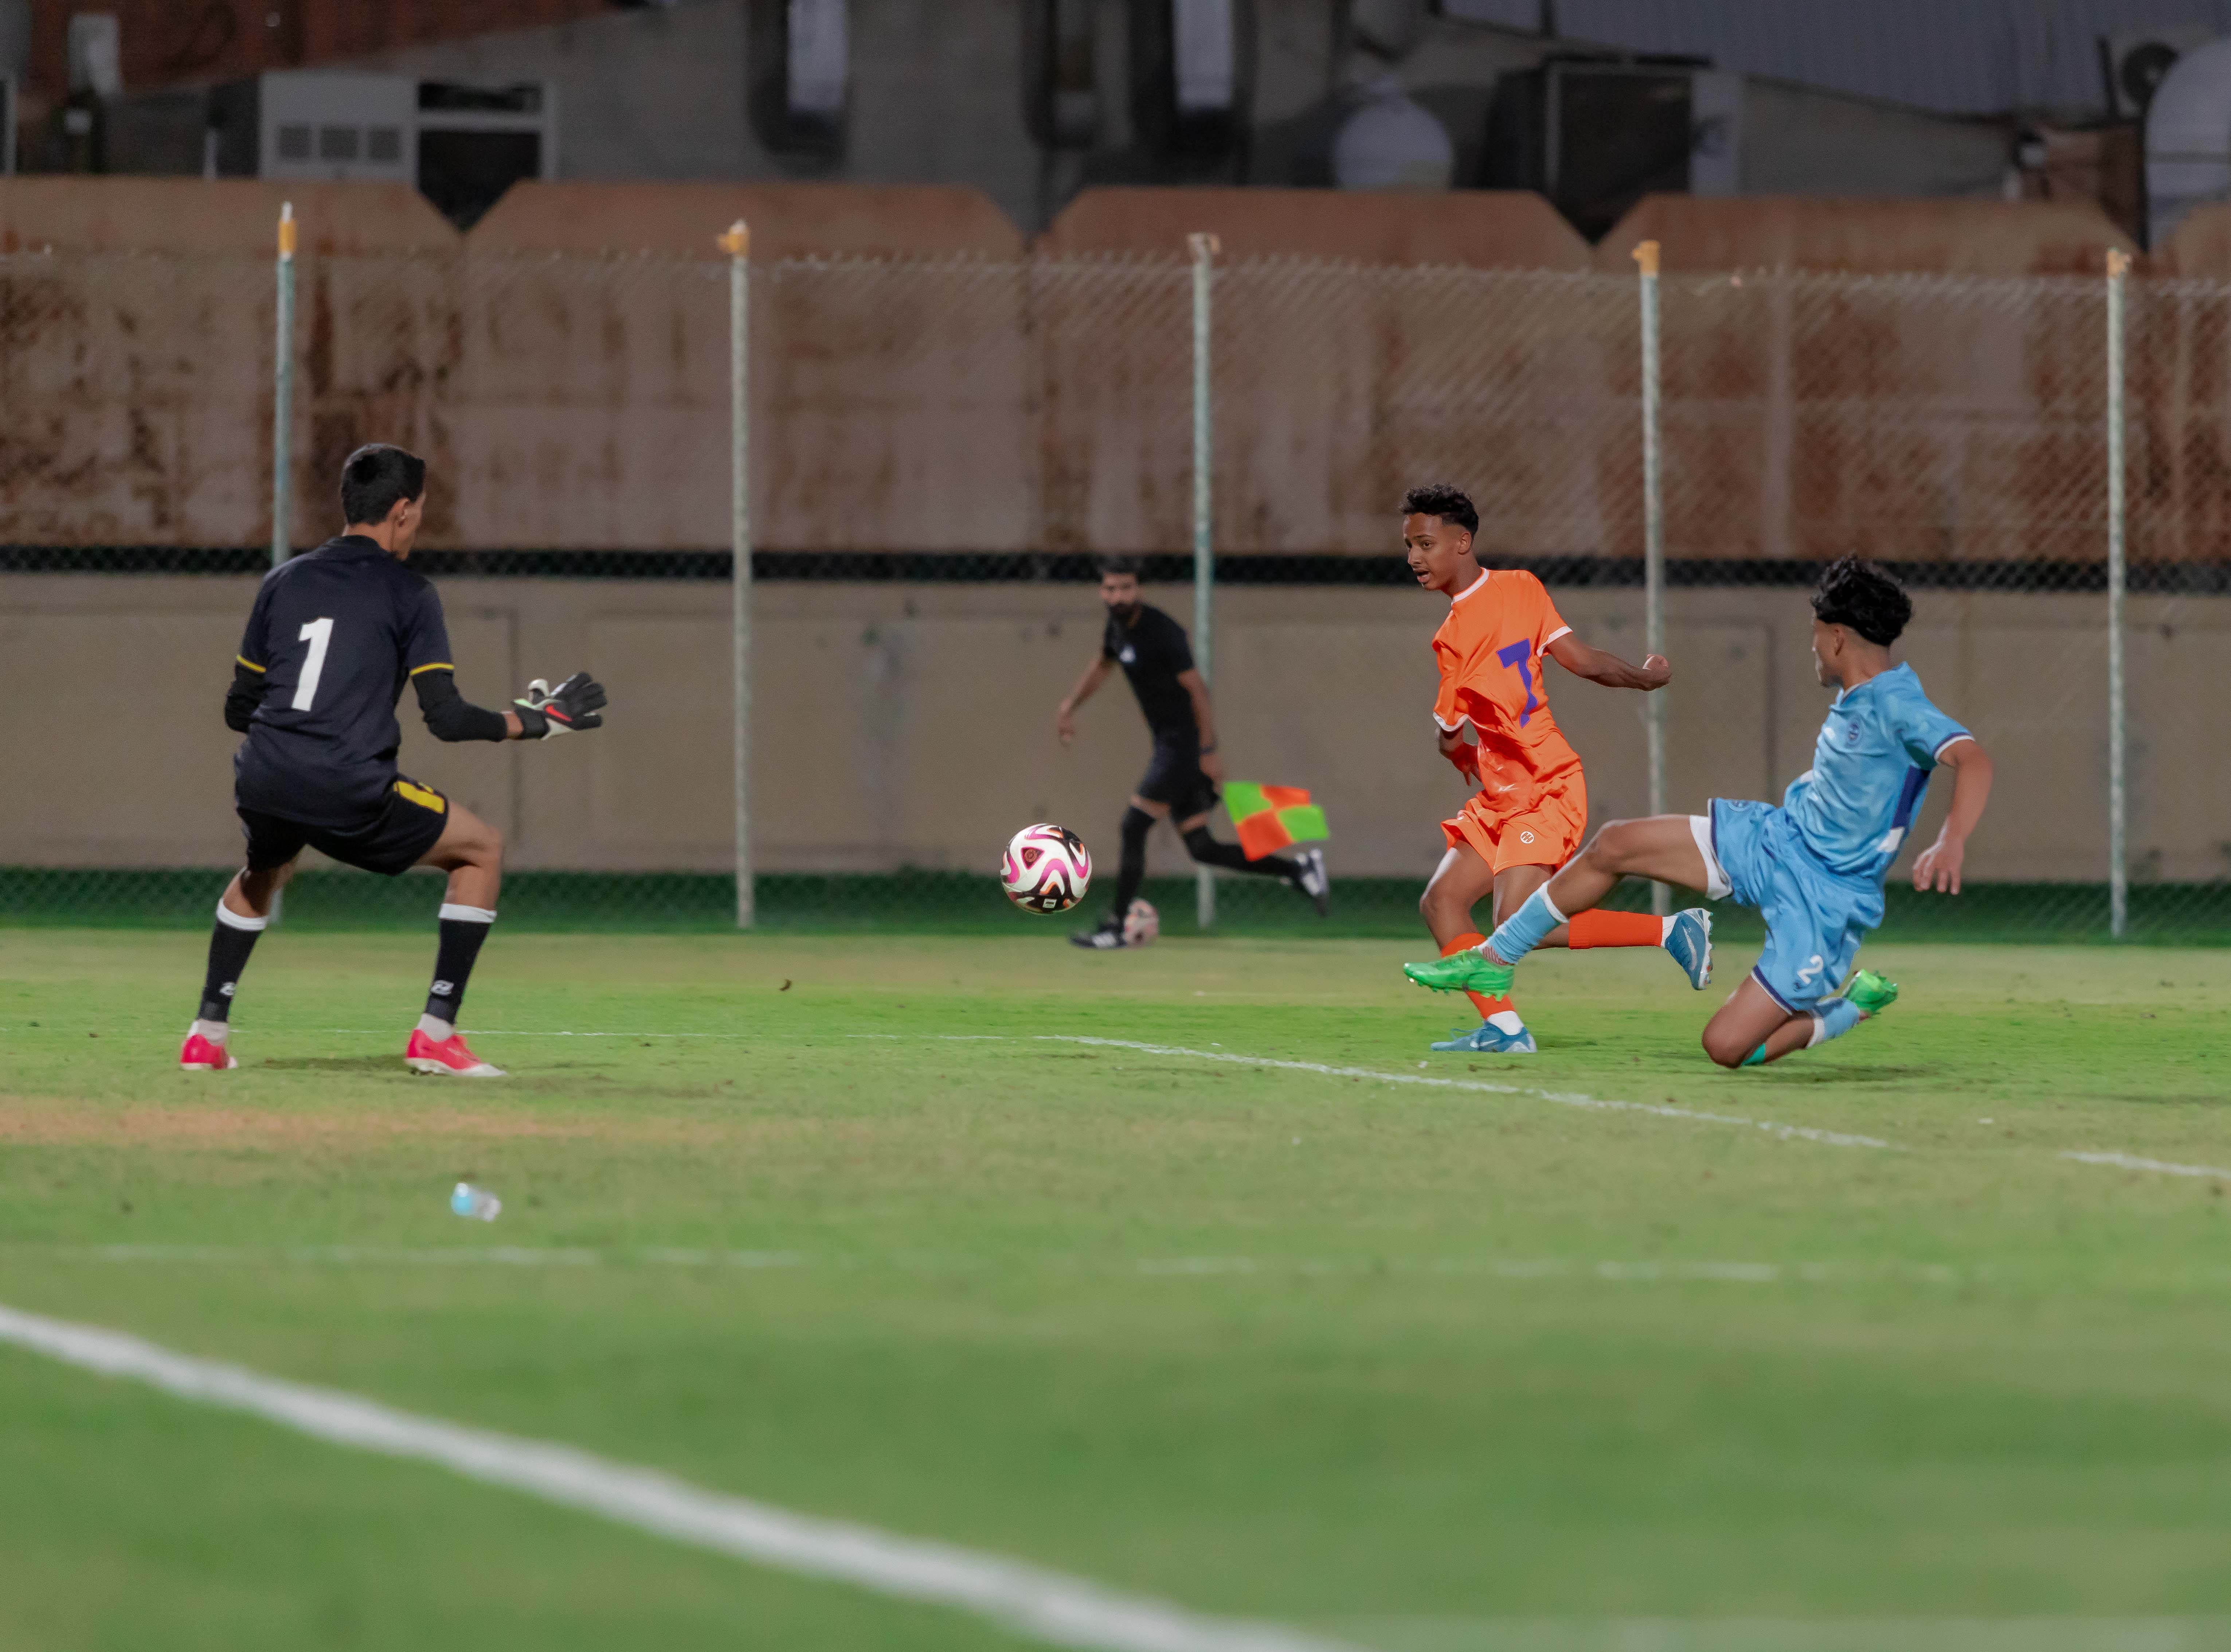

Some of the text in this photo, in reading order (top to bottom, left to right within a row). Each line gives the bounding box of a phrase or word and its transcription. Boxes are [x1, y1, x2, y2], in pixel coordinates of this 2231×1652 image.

[291, 617, 334, 712] 1
[1496, 638, 1539, 728] 7
[1797, 954, 1824, 985] 2
